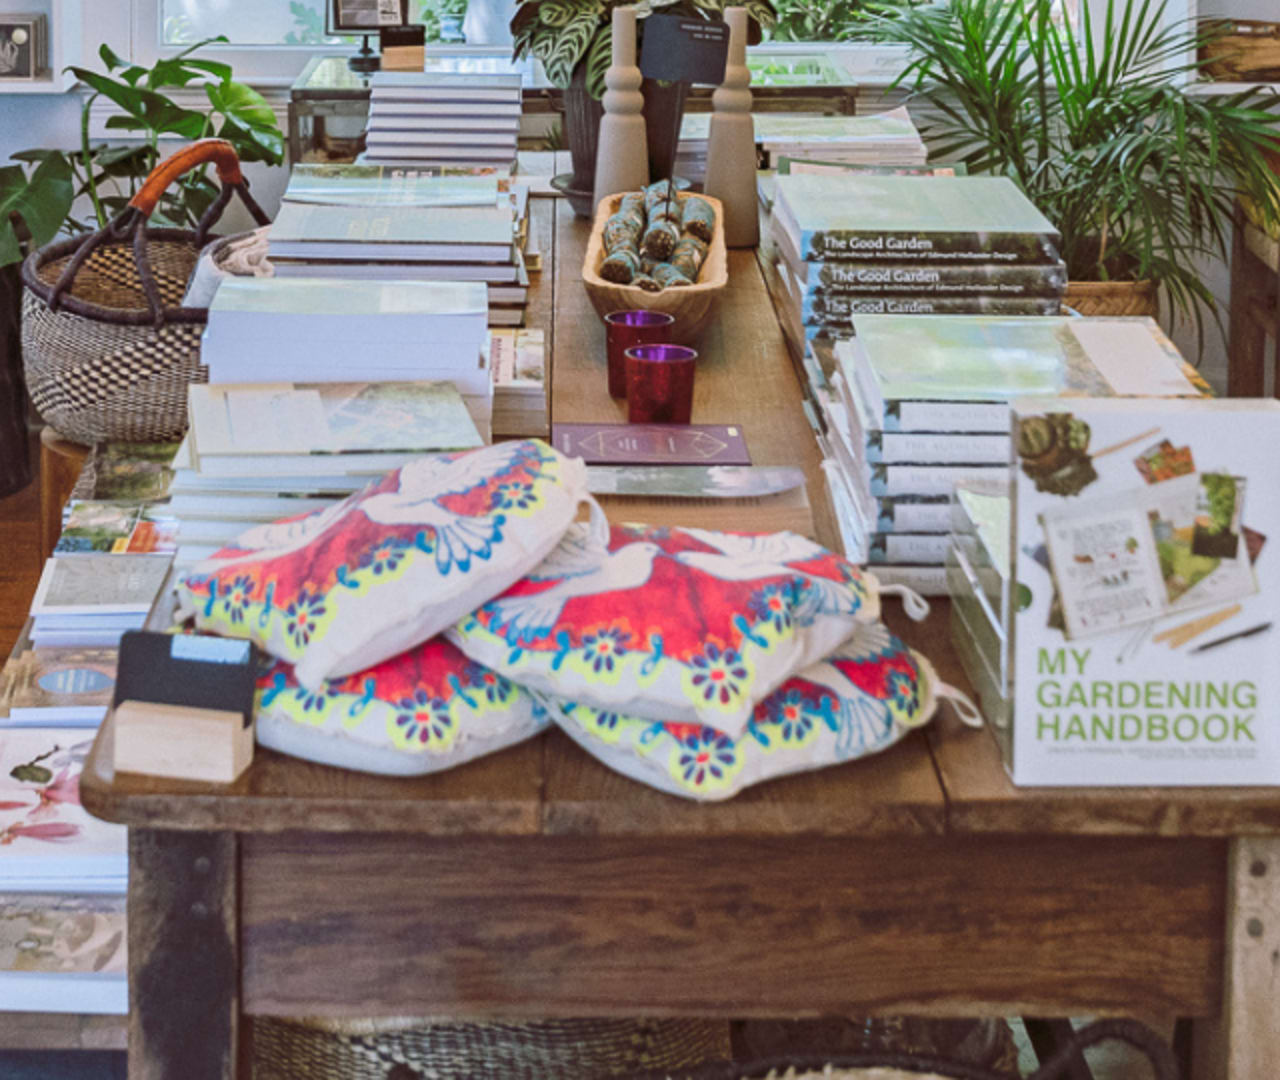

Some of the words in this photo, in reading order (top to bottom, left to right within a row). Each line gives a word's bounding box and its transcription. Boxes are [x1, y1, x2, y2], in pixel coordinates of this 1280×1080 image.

[823, 236, 847, 250] The
[849, 236, 884, 250] Good
[887, 236, 933, 250] Garden
[831, 268, 854, 282] The
[857, 269, 890, 283] Good
[893, 269, 940, 283] Garden
[824, 300, 848, 314] The
[850, 301, 884, 314] Good
[887, 301, 934, 314] Garden
[1036, 648, 1092, 676] MY
[1036, 680, 1258, 710] GARDENING
[1036, 713, 1257, 743] HANDBOOK
